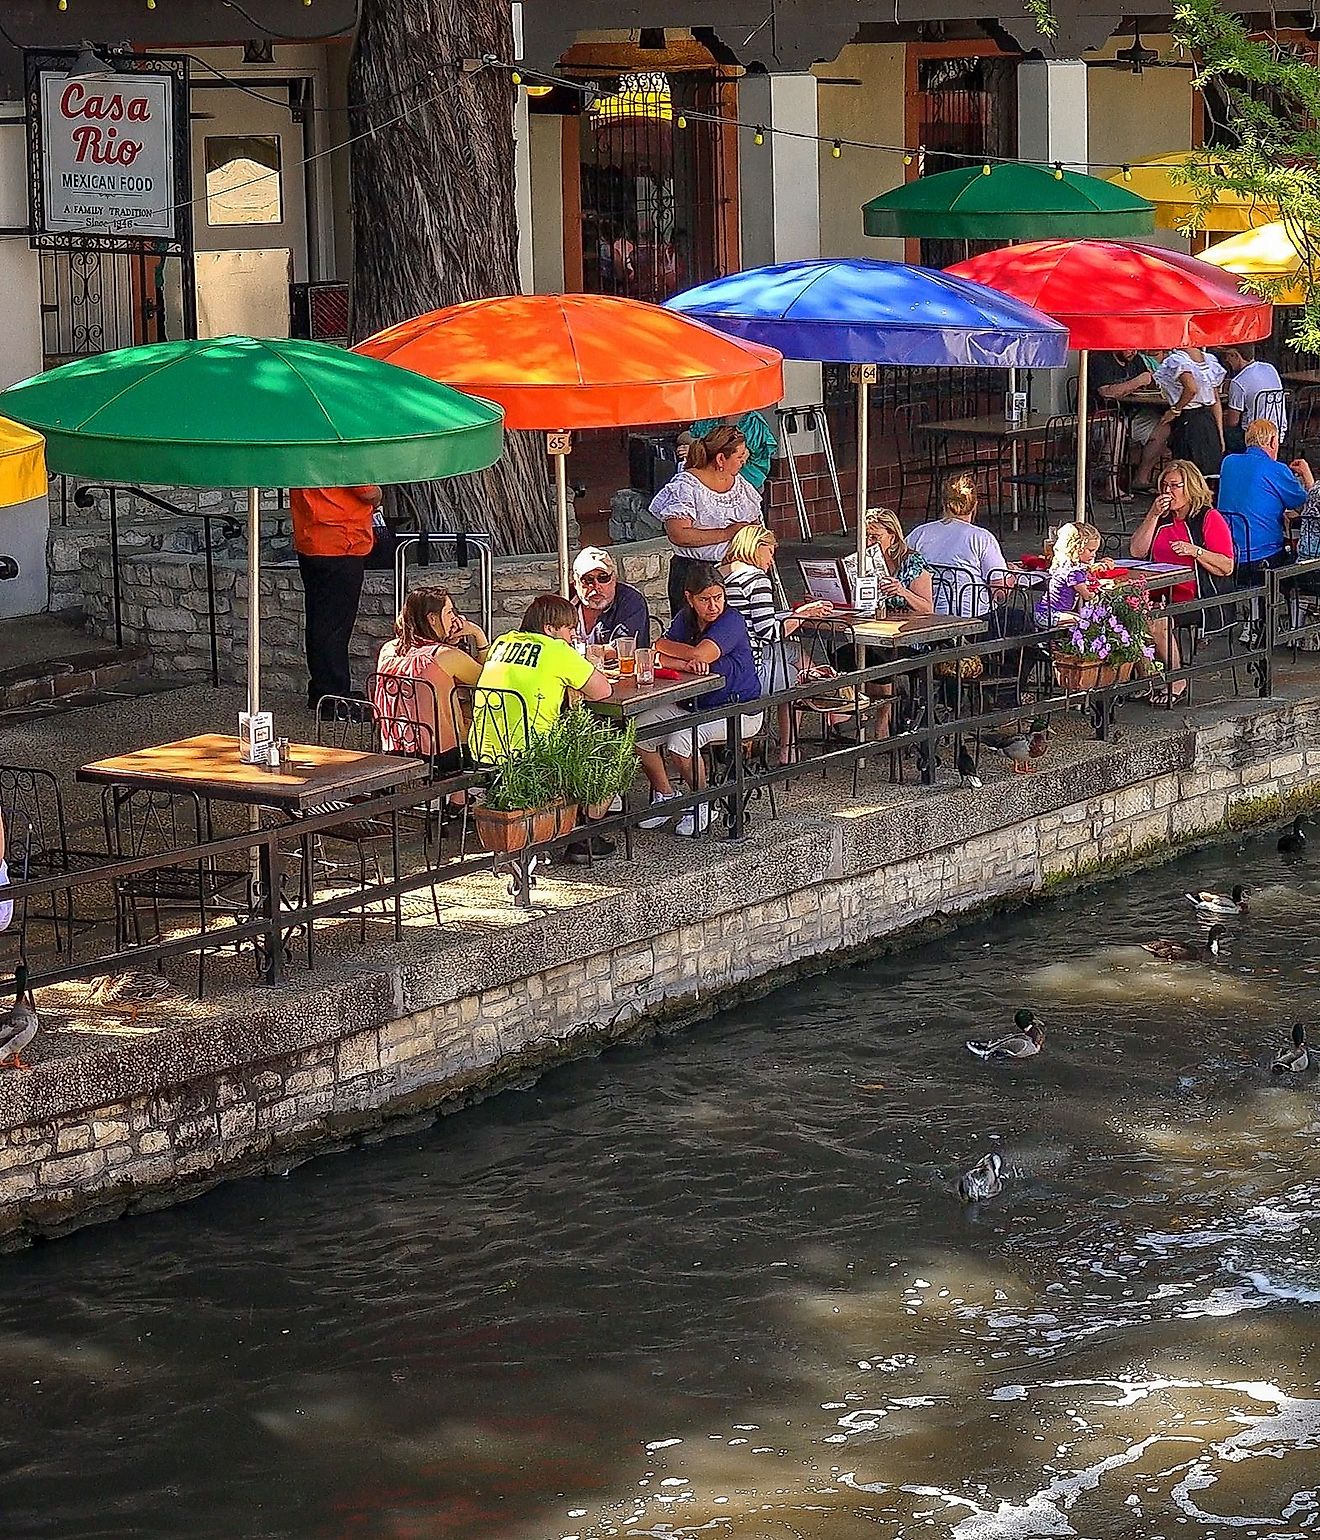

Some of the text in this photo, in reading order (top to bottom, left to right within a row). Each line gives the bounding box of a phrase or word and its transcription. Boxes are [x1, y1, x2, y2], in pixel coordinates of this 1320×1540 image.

[60, 81, 153, 122] Casa
[71, 124, 144, 167] Rio
[61, 173, 153, 192] MEXICAN FOOD
[63, 204, 153, 218] A FAMILY TRADITION
[85, 217, 109, 228] Since
[863, 367, 875, 378] 64
[550, 437, 565, 449] 65
